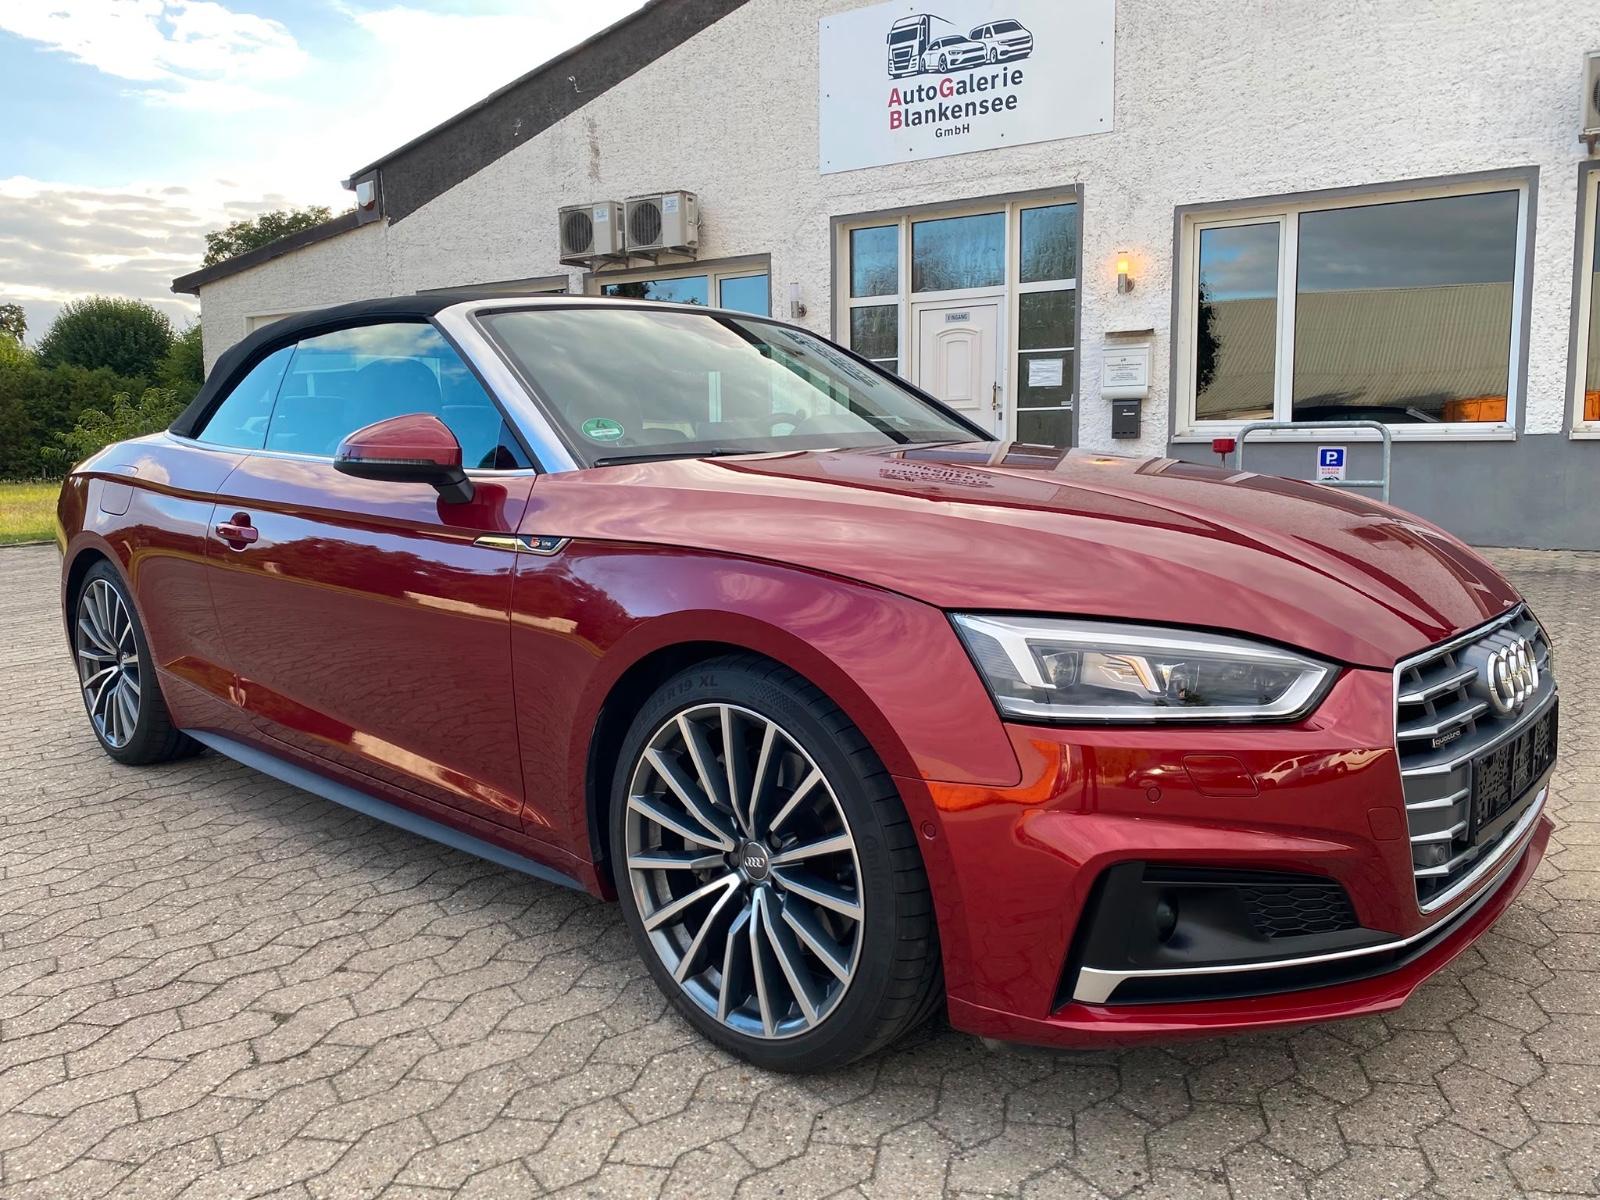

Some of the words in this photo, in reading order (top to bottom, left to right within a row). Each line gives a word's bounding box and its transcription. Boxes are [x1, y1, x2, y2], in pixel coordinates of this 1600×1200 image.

[888, 67, 1023, 107] AutoGalerie
[890, 94, 1018, 129] Blankensee
[935, 123, 970, 138] GmbH
[1326, 451, 1338, 465] P
[699, 674, 719, 688] XL
[1434, 730, 1461, 747] quattro
